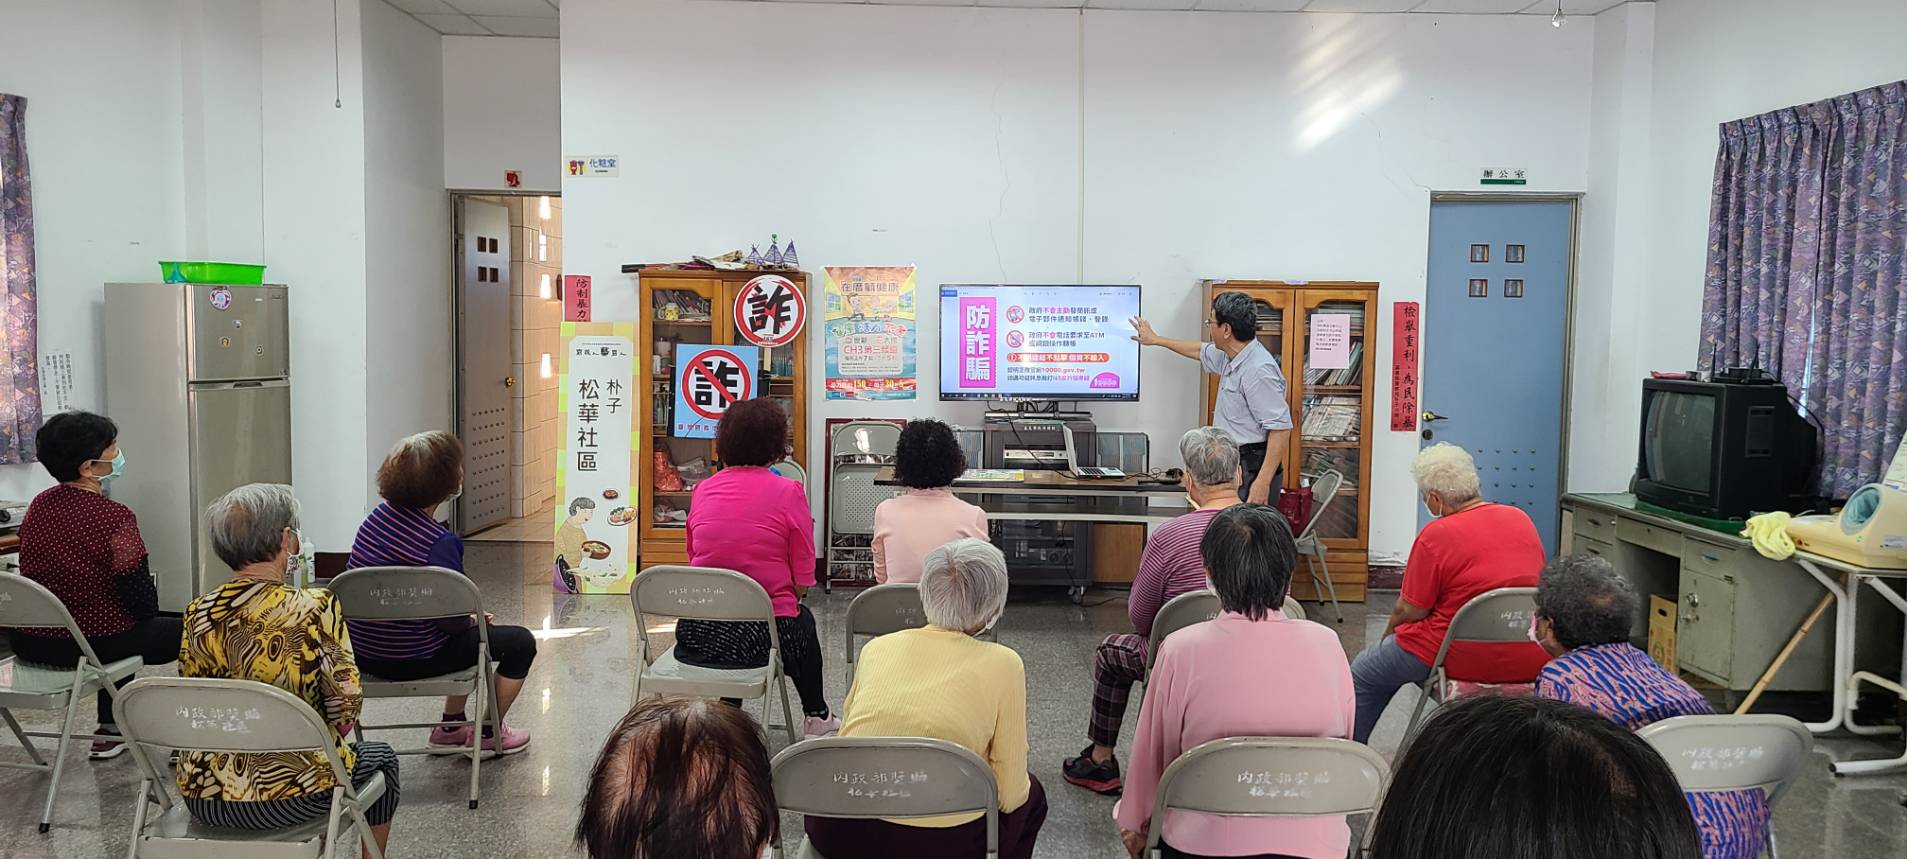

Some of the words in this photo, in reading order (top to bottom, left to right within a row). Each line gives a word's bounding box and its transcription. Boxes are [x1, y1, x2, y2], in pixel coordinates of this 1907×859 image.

[576, 278, 588, 322] 防制暴力
[747, 284, 794, 335] 詐
[965, 304, 991, 381] 防詐騙
[606, 378, 623, 415] 朴子
[694, 360, 740, 409] 詐
[577, 378, 600, 472] 松華社區
